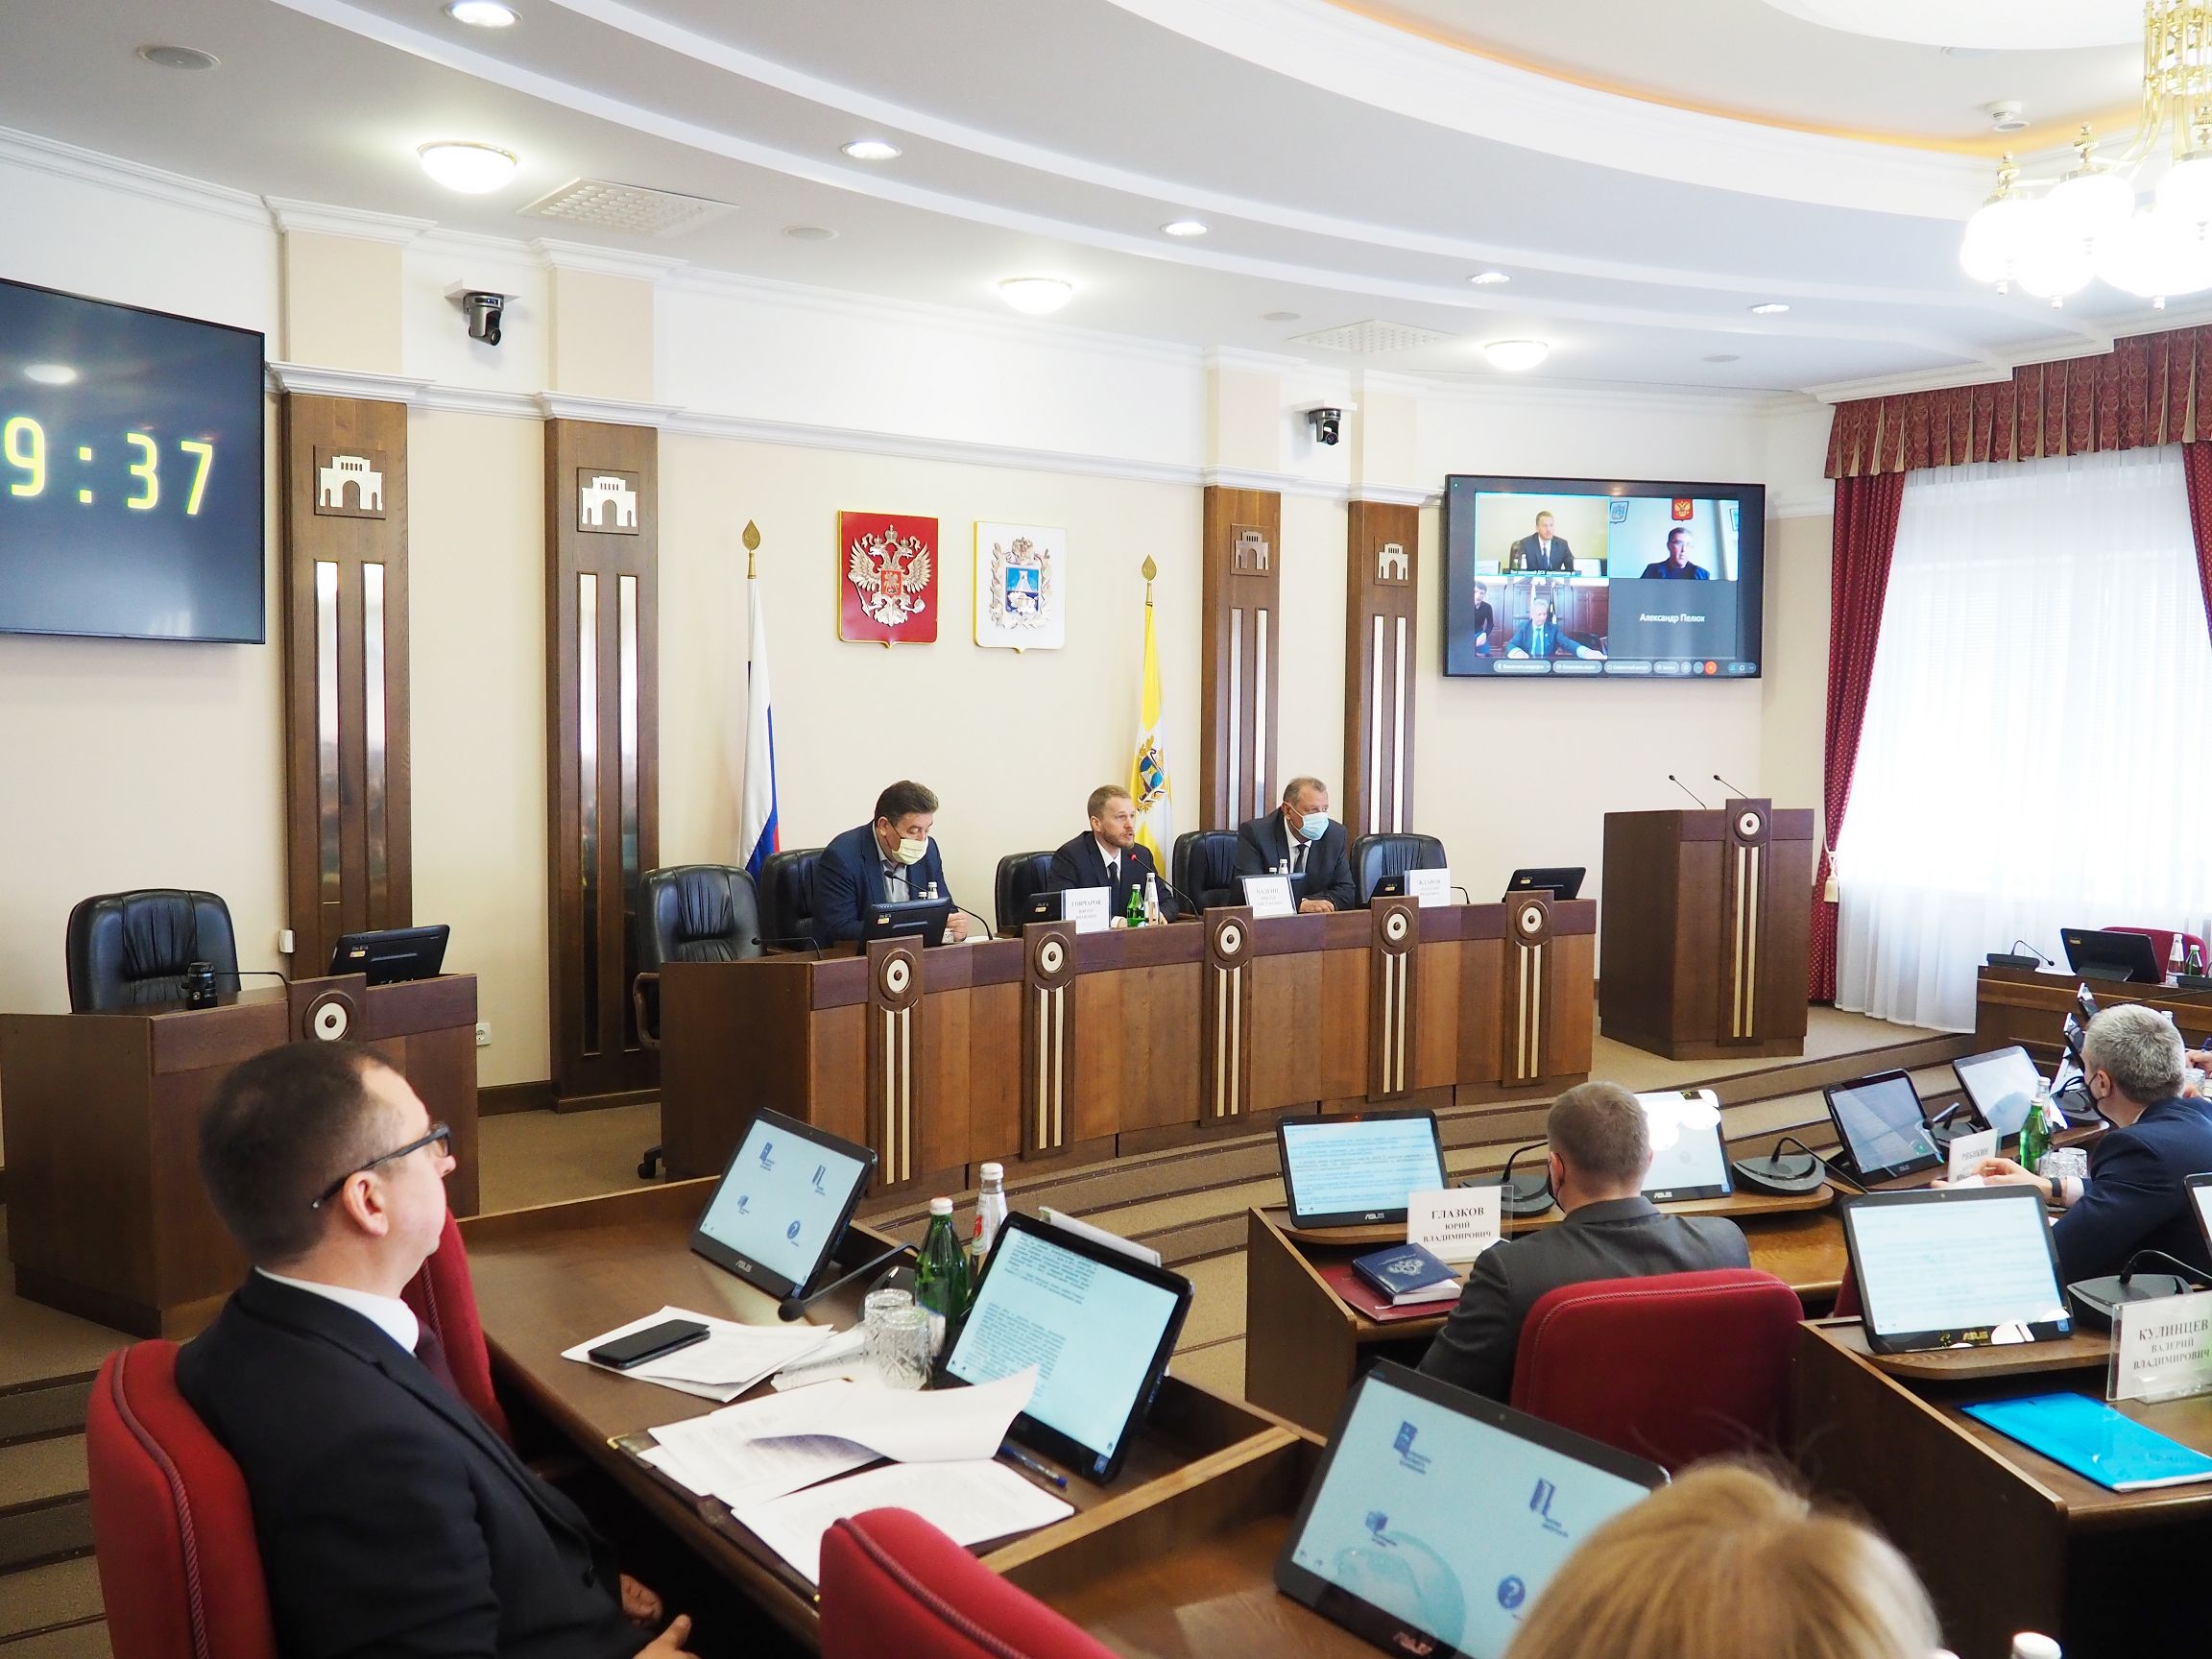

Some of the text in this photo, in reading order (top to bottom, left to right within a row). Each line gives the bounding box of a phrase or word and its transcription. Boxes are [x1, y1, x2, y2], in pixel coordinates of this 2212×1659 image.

[1639, 613, 1680, 624] Александр
[1431, 1207, 1484, 1220] ГЛАЗКОВ
[1445, 1220, 1471, 1230] ЮРИЙ
[1423, 1231, 1492, 1243] ВЛАДИМИРОВИЧ
[1962, 1331, 1989, 1341] ASUS
[2138, 1319, 2209, 1341] КУЛИНЦЕВ
[2152, 1337, 2195, 1354] ВАЛЕРИЙ
[2132, 1348, 2210, 1370] ВЛАДИМИРОВИЧ
